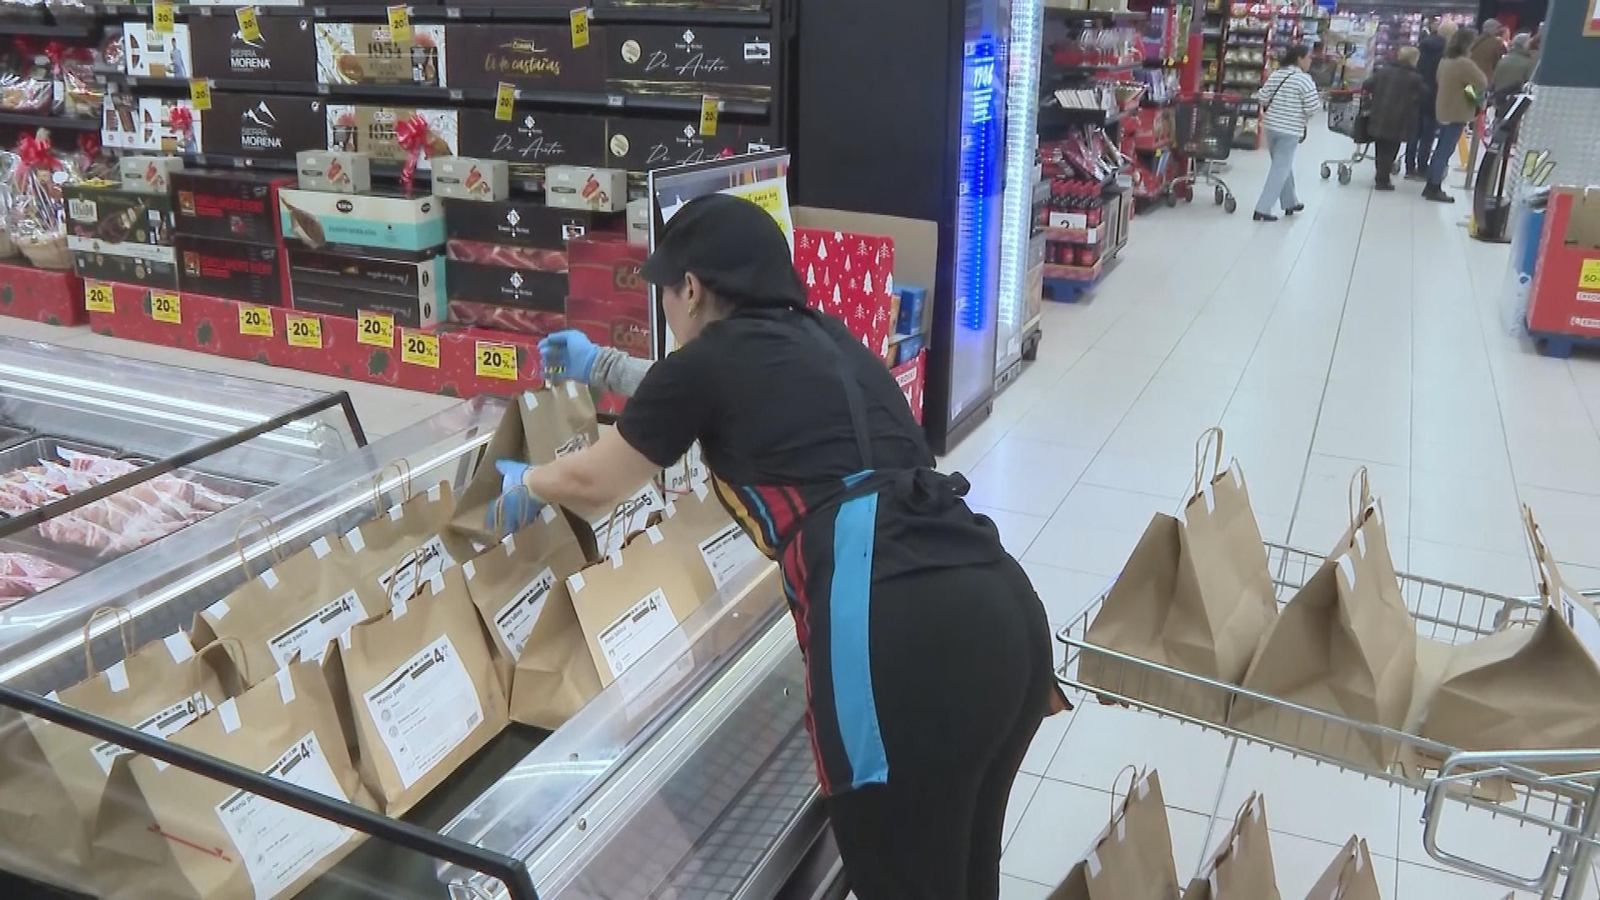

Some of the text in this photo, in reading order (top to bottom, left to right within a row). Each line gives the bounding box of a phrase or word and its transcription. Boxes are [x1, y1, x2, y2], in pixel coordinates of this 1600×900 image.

[231, 58, 269, 69] MORENA
[369, 123, 396, 140] 195
[242, 137, 281, 149] MORENA
